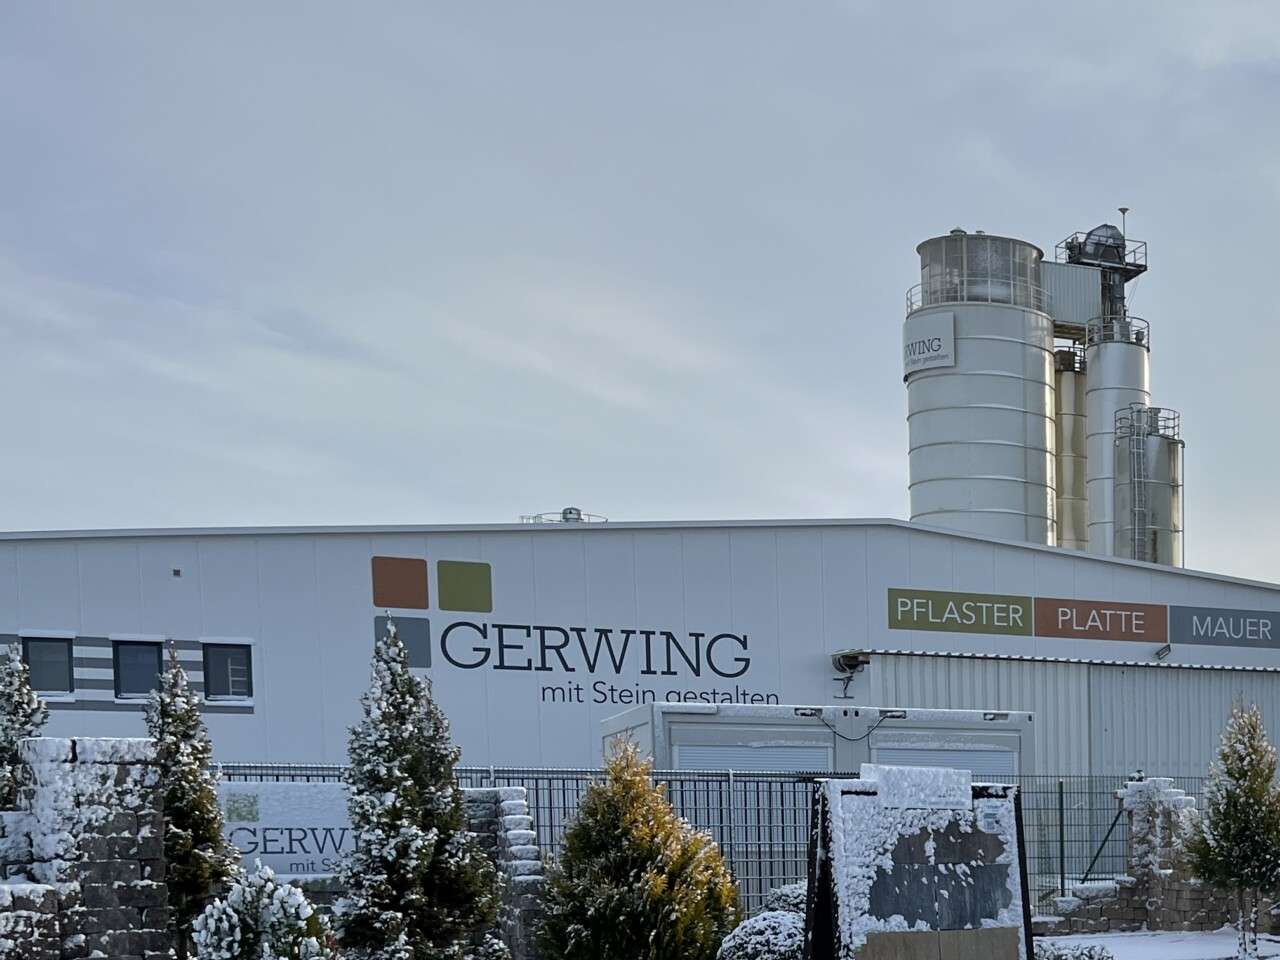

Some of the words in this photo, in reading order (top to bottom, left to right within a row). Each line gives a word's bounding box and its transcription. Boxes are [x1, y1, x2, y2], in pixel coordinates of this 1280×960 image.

[897, 598, 1024, 627] PFLASTER
[1058, 607, 1145, 634] PLATTE
[1192, 615, 1272, 640] MAUER
[440, 621, 751, 679] GERWING
[541, 681, 584, 703] mit
[592, 680, 656, 704] Stein
[665, 685, 780, 705] gestalten
[229, 827, 359, 855] GERWI
[289, 859, 316, 873] mit
